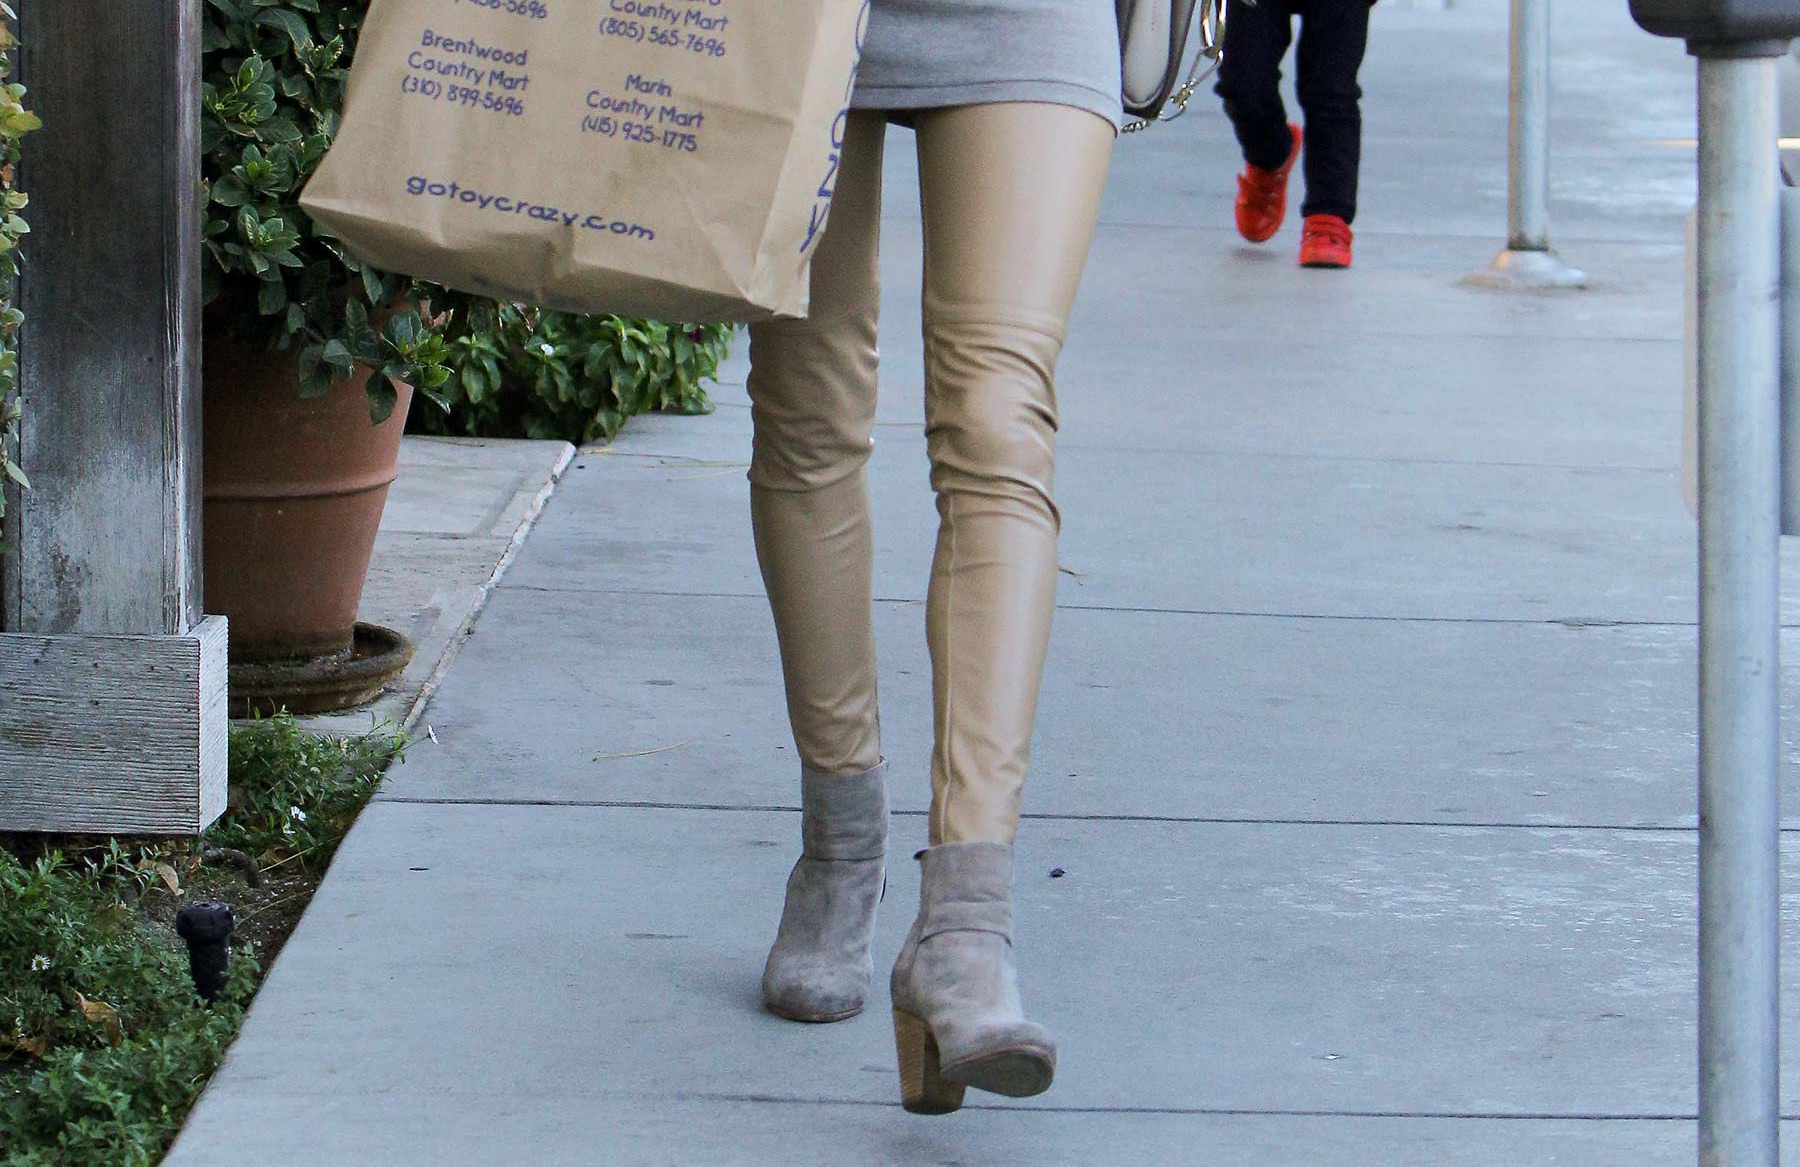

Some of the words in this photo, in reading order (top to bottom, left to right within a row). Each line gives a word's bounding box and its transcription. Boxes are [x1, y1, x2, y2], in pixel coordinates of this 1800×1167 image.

[599, 16, 645, 43] (805)
[649, 29, 726, 58] 565-7696
[683, 8, 729, 32] Mart
[421, 28, 528, 67] Brentwood
[407, 50, 485, 85] Country
[488, 69, 530, 92] Mart
[624, 73, 672, 98] Marin
[401, 74, 442, 100] (310)
[446, 86, 524, 116] 899-5696
[586, 90, 655, 121] Country
[658, 105, 705, 129] Mart
[581, 114, 618, 138] (415)
[622, 121, 698, 152] 925-1775
[405, 175, 655, 241] gotoycrazy.com
